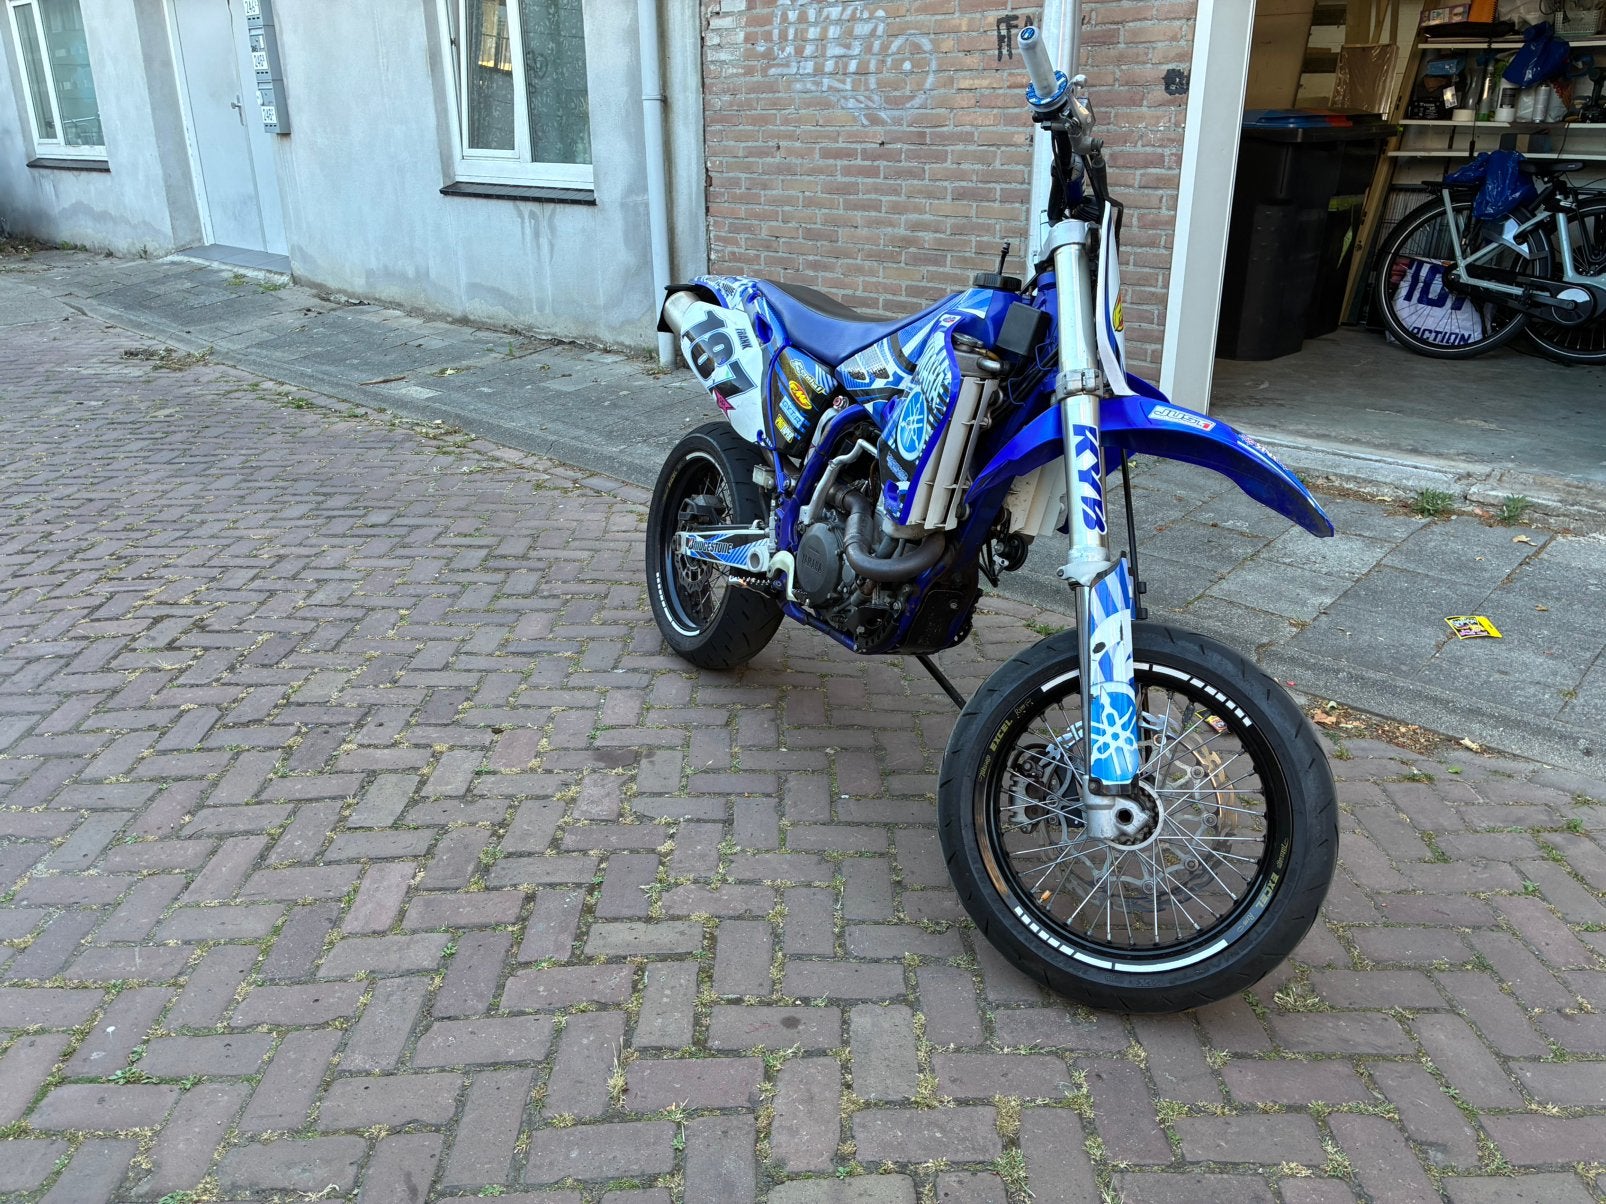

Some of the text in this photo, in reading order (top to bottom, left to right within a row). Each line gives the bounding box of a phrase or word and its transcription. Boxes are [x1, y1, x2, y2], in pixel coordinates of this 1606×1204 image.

[682, 310, 758, 399] 187
[735, 328, 752, 350] FRANK
[1072, 423, 1107, 535] KYB
[688, 536, 733, 555] BRIDGESTONE
[989, 719, 1013, 752] EXCEL
[1256, 872, 1280, 908] EXCEL
